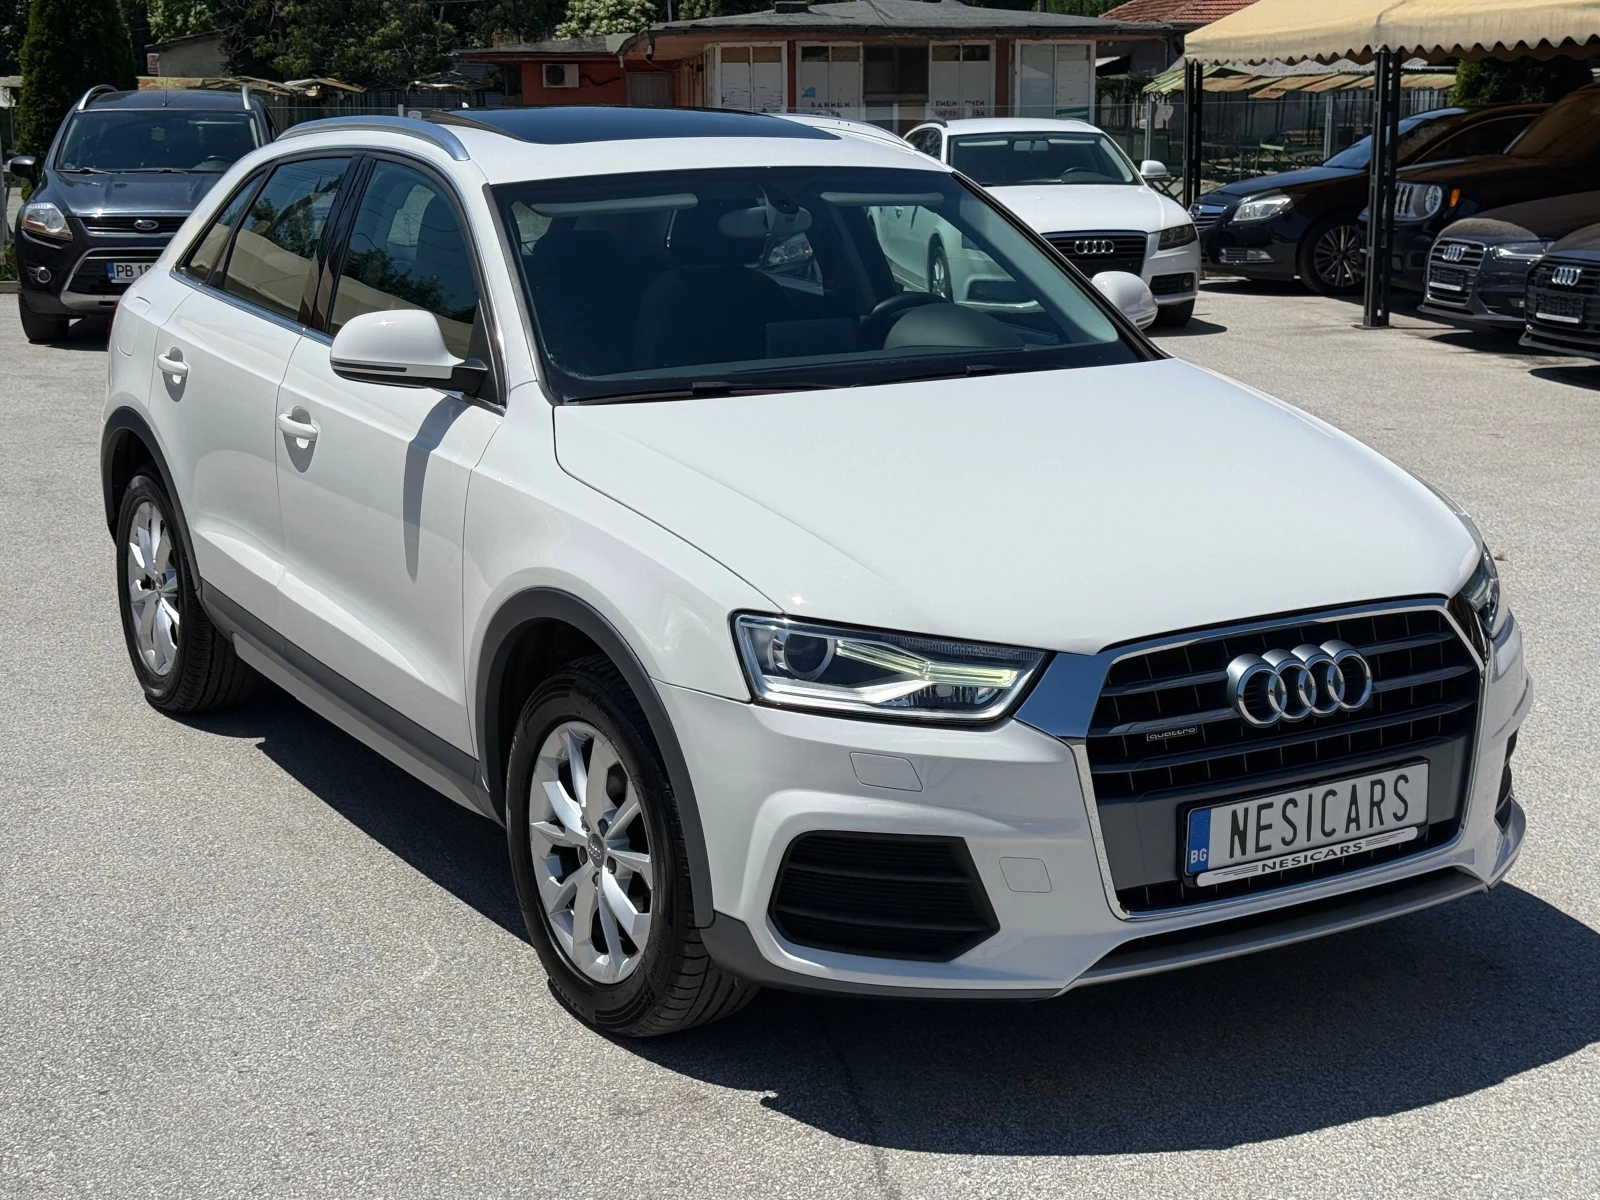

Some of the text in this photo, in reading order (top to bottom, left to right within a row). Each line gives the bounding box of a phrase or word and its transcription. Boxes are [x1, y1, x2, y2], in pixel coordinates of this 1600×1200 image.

[116, 264, 134, 277] PB
[1149, 727, 1196, 740] quattro
[1229, 774, 1409, 859] NESICARS
[1190, 847, 1208, 864] BG
[1261, 842, 1363, 872] NESICARS
